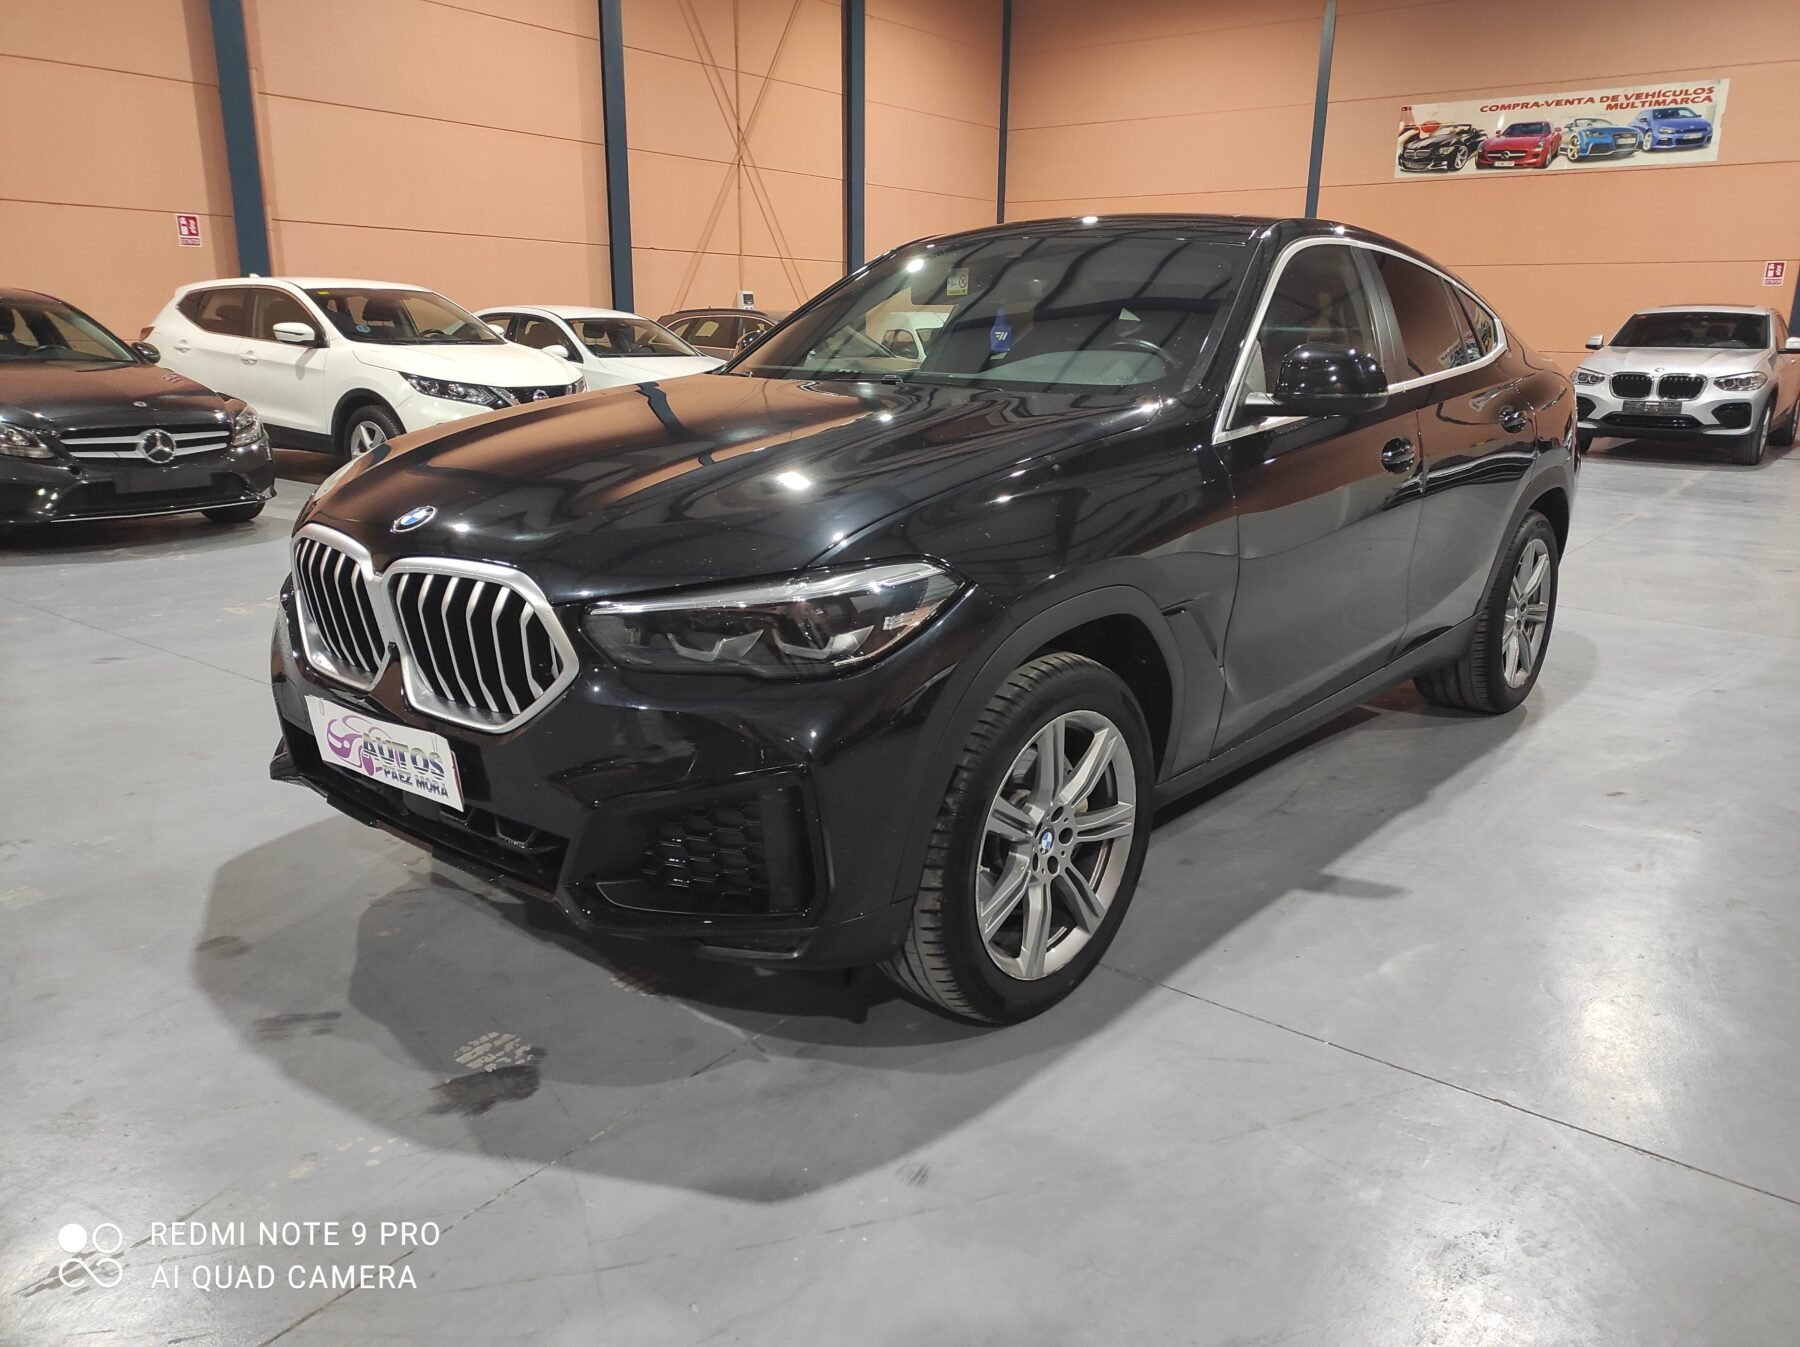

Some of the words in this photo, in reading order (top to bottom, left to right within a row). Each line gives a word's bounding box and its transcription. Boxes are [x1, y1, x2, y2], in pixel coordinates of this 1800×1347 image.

[1480, 97, 1595, 112] COMPRA-VENTA
[1600, 95, 1620, 103] DE
[1624, 86, 1715, 101] VEHÍCULOS
[1605, 95, 1713, 110] MULTIMARCA
[363, 732, 445, 780] AUTOS
[414, 774, 449, 798] MORA
